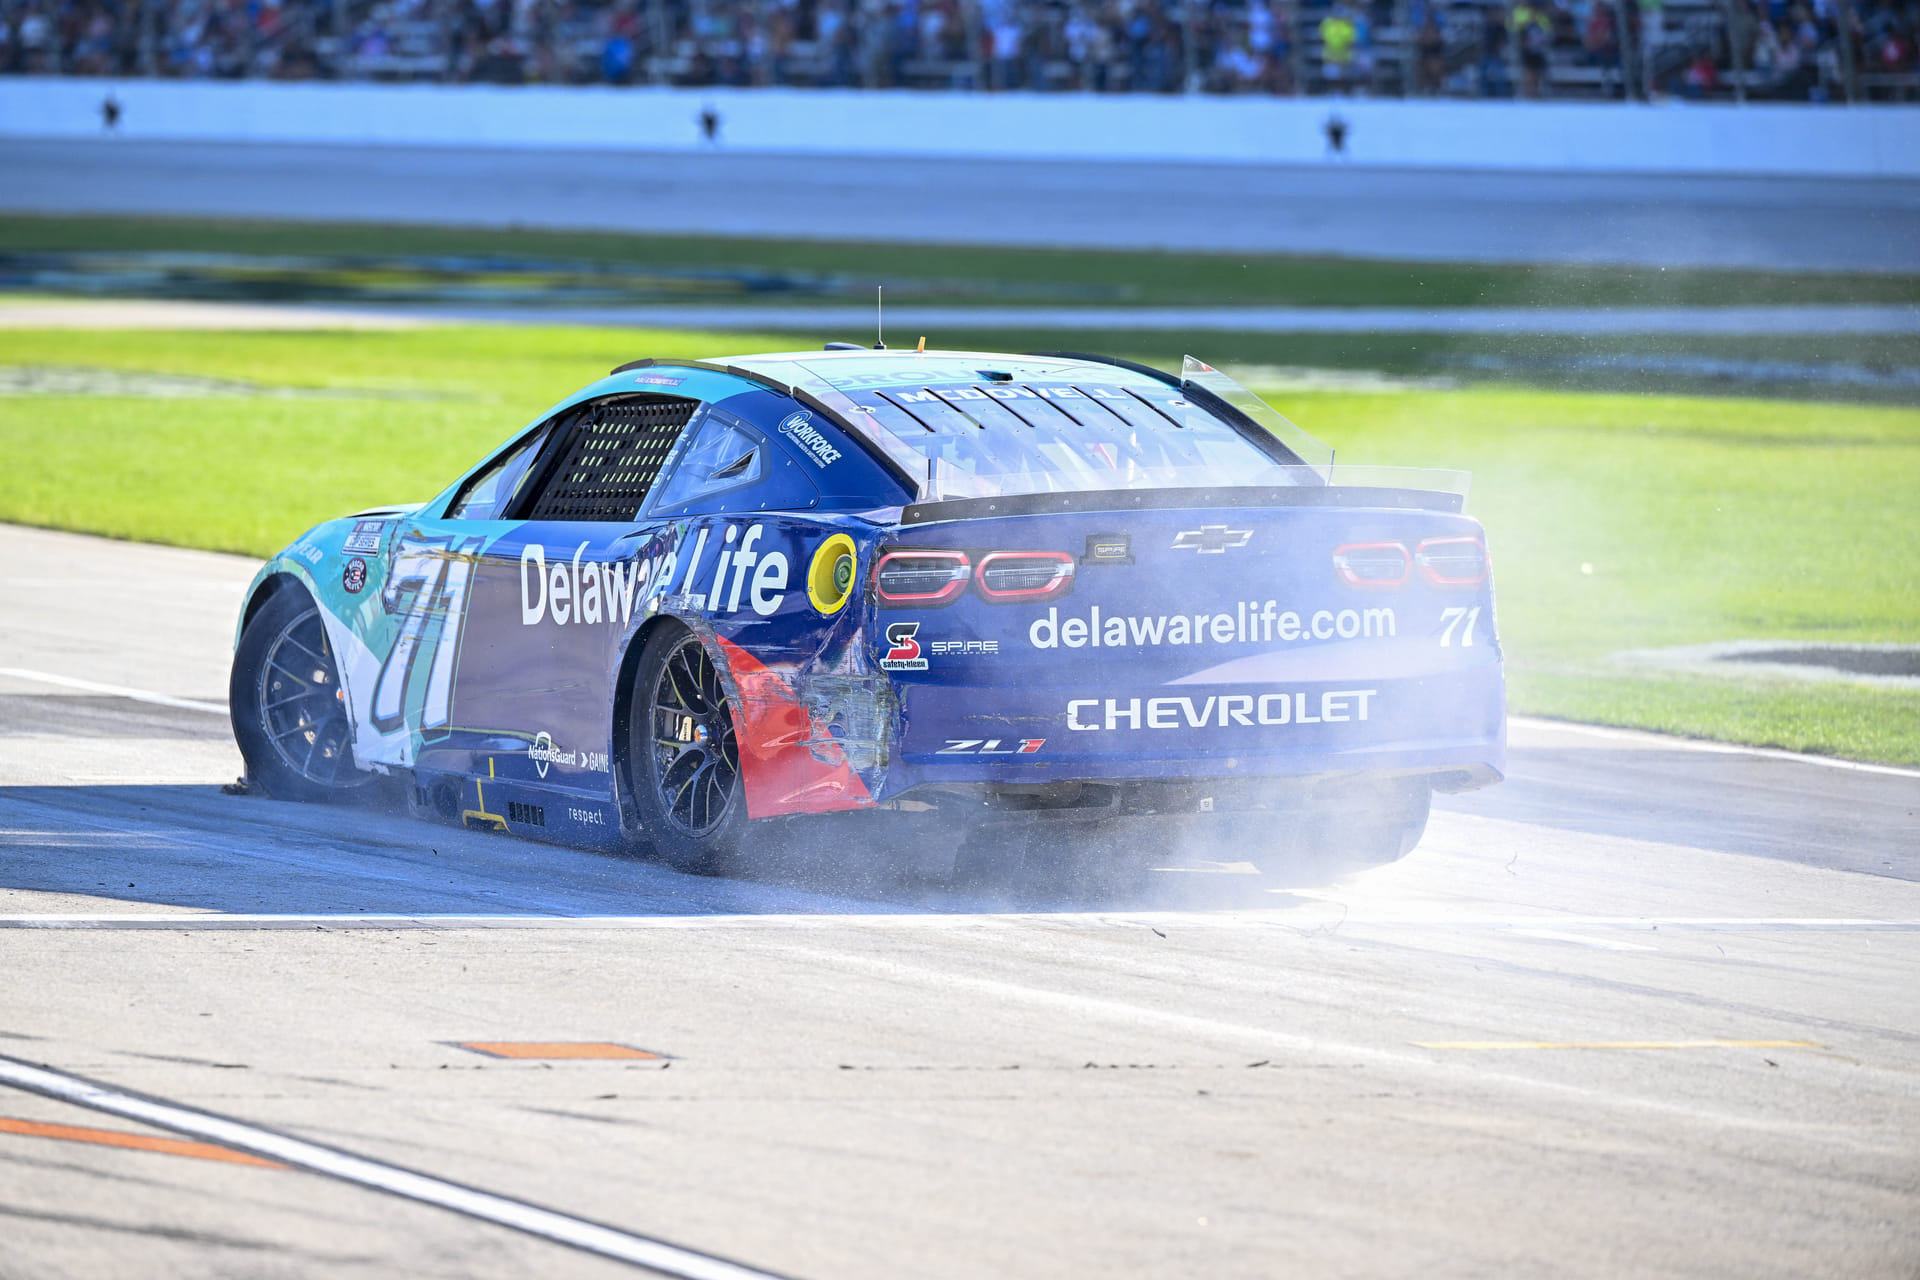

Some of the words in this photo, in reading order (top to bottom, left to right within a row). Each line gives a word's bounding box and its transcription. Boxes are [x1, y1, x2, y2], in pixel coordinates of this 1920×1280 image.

[805, 369, 978, 387] GROU
[898, 385, 1127, 403] MCDOWELL
[787, 415, 842, 464] WORKFORCE
[521, 541, 678, 629] Delaware
[681, 524, 789, 616] Life
[1029, 600, 1396, 649] delawarelife.com
[1440, 607, 1480, 647] 71
[371, 536, 486, 743] 71
[931, 641, 998, 652] SPIRE
[882, 660, 926, 670] safety-kleen
[1067, 689, 1377, 731] CHEVROLET
[528, 745, 576, 765] NationsGuard
[935, 739, 1046, 754] ZL1
[568, 807, 606, 825] respect.
